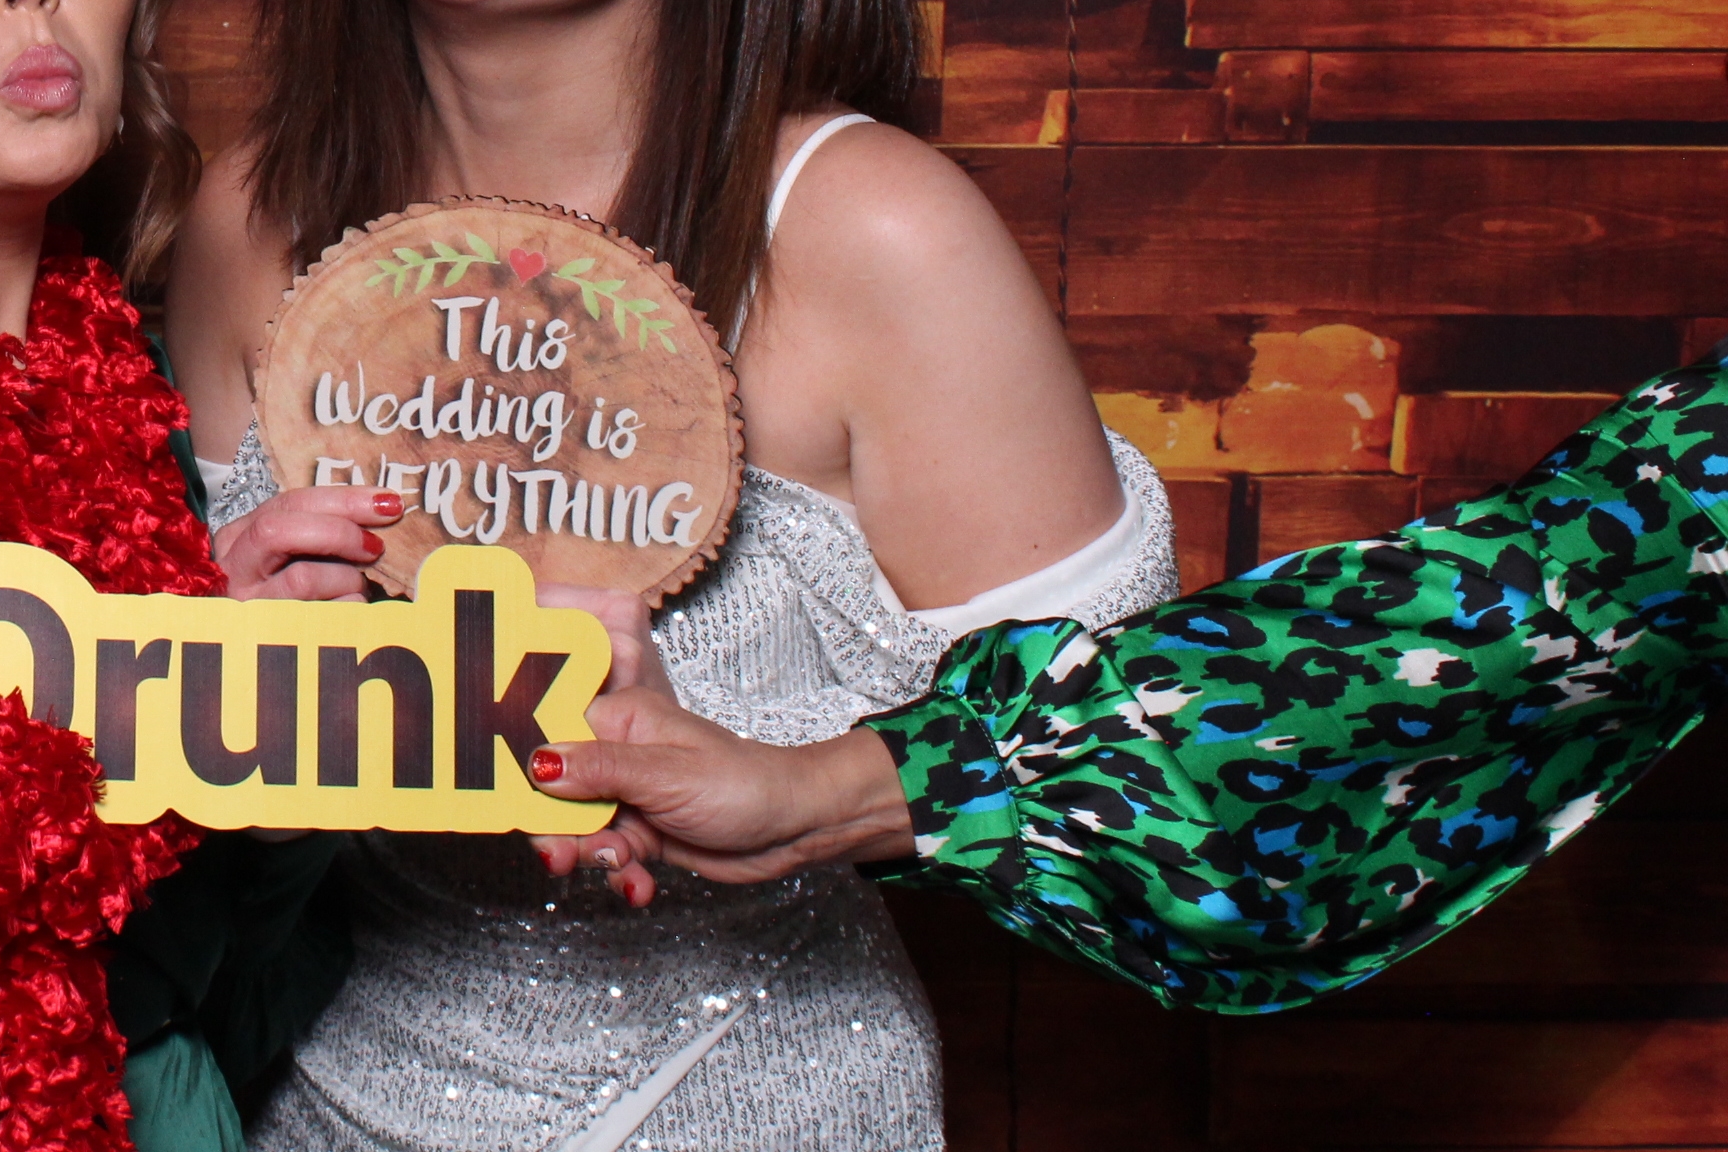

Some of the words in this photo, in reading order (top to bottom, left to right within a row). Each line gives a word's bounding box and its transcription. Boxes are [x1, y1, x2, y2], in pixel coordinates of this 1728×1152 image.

[431, 295, 576, 372] This
[314, 359, 574, 461] Wedding
[586, 395, 647, 459] is
